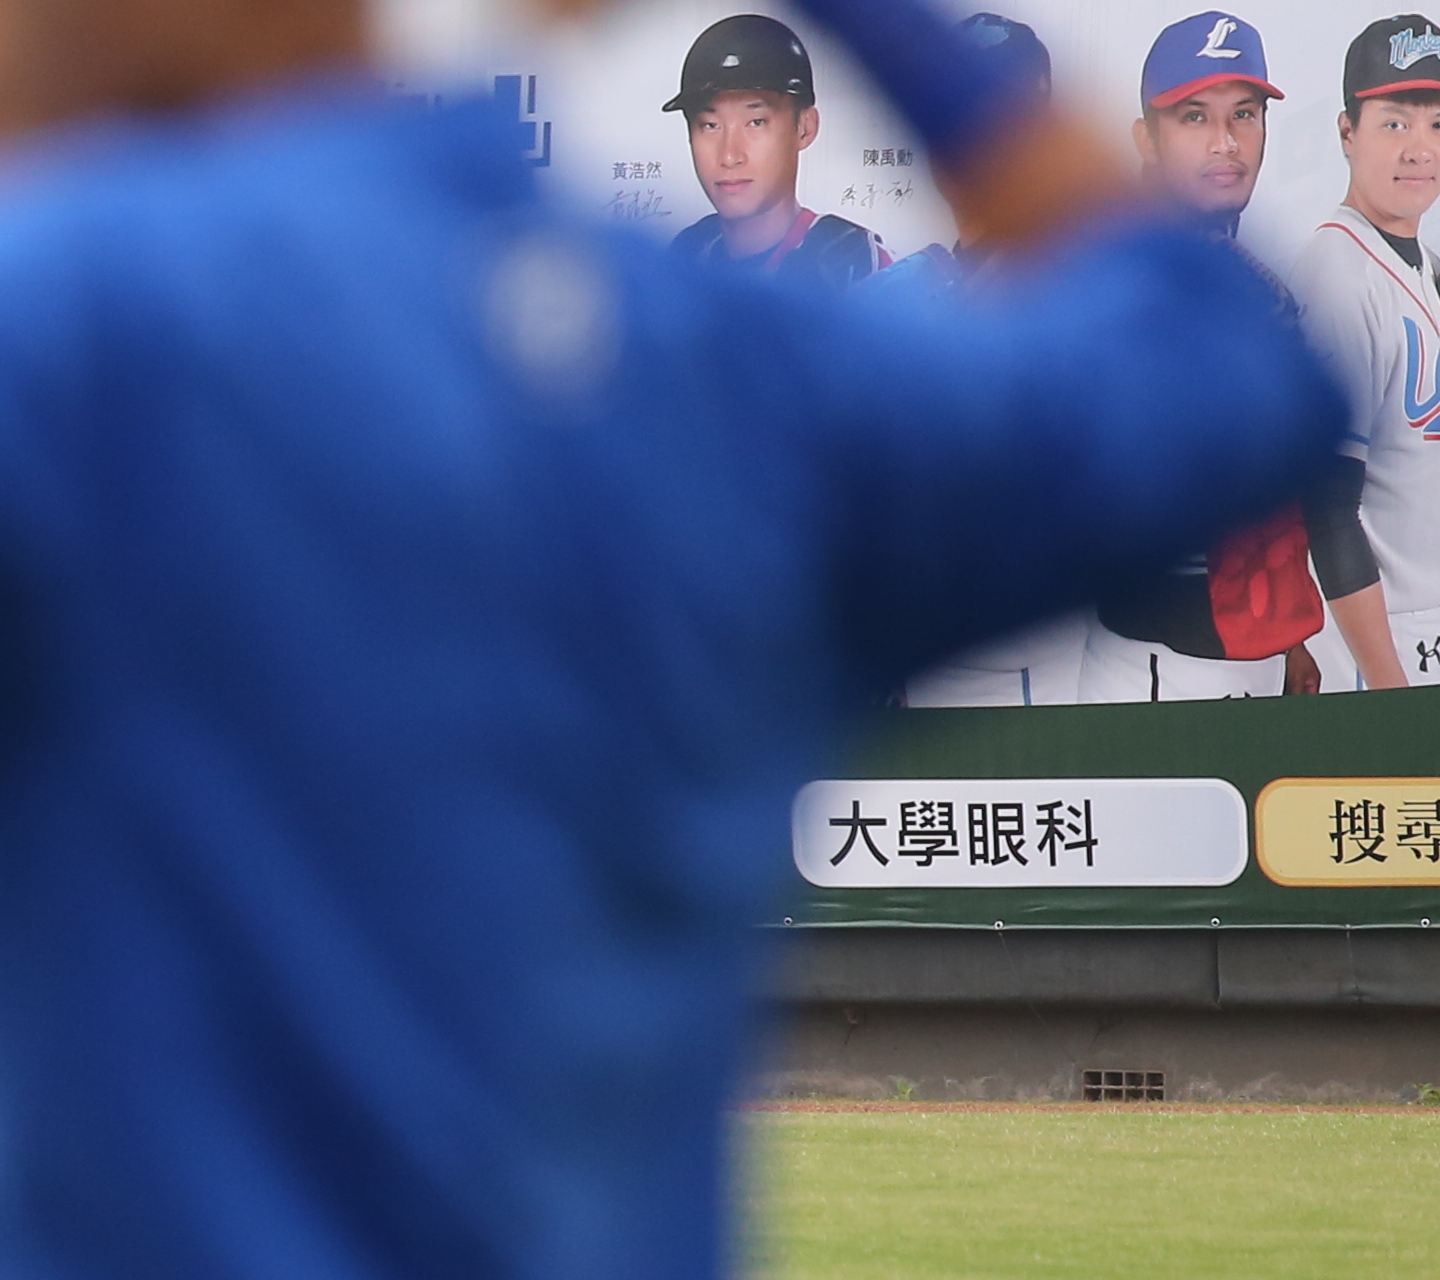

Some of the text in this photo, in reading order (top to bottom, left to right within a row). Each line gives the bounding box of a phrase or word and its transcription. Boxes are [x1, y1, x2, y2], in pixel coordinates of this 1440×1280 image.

[611, 161, 663, 181] 黃浩然
[828, 799, 1099, 868] 大學眼科
[1328, 798, 1440, 866] 搜尋
